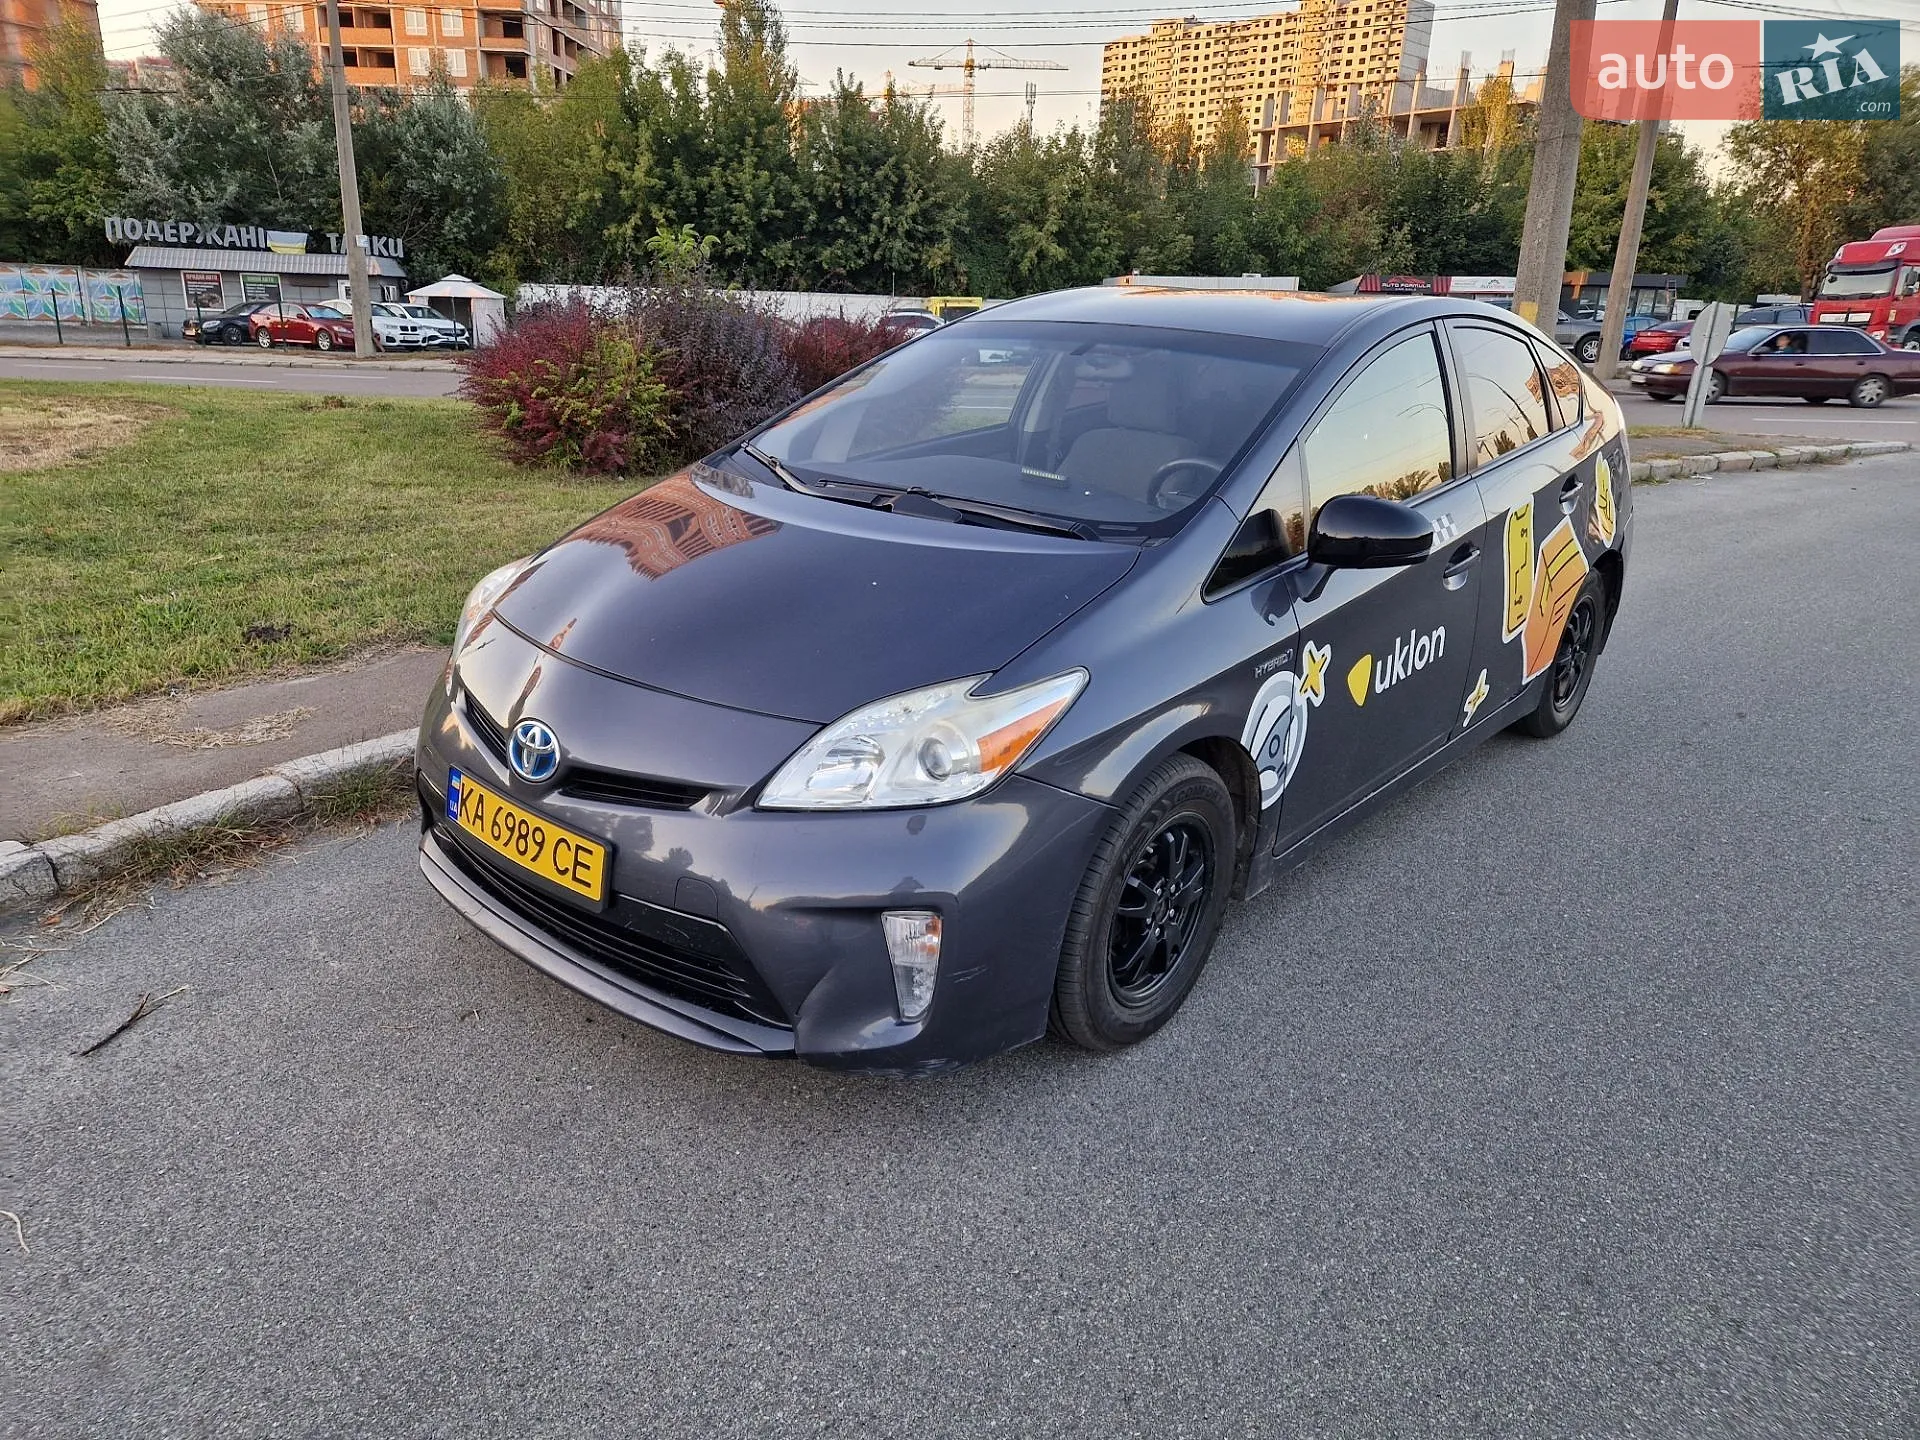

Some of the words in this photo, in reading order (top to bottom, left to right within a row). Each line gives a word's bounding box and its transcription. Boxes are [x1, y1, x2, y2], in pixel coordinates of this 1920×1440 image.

[105, 217, 265, 249] ПОДЕРЖАНІ
[326, 232, 404, 258] ТКИ
[1375, 625, 1446, 694] uklon
[449, 799, 458, 815] UA
[459, 782, 485, 832] KA
[491, 806, 546, 863] 6989
[552, 837, 594, 888] CE
